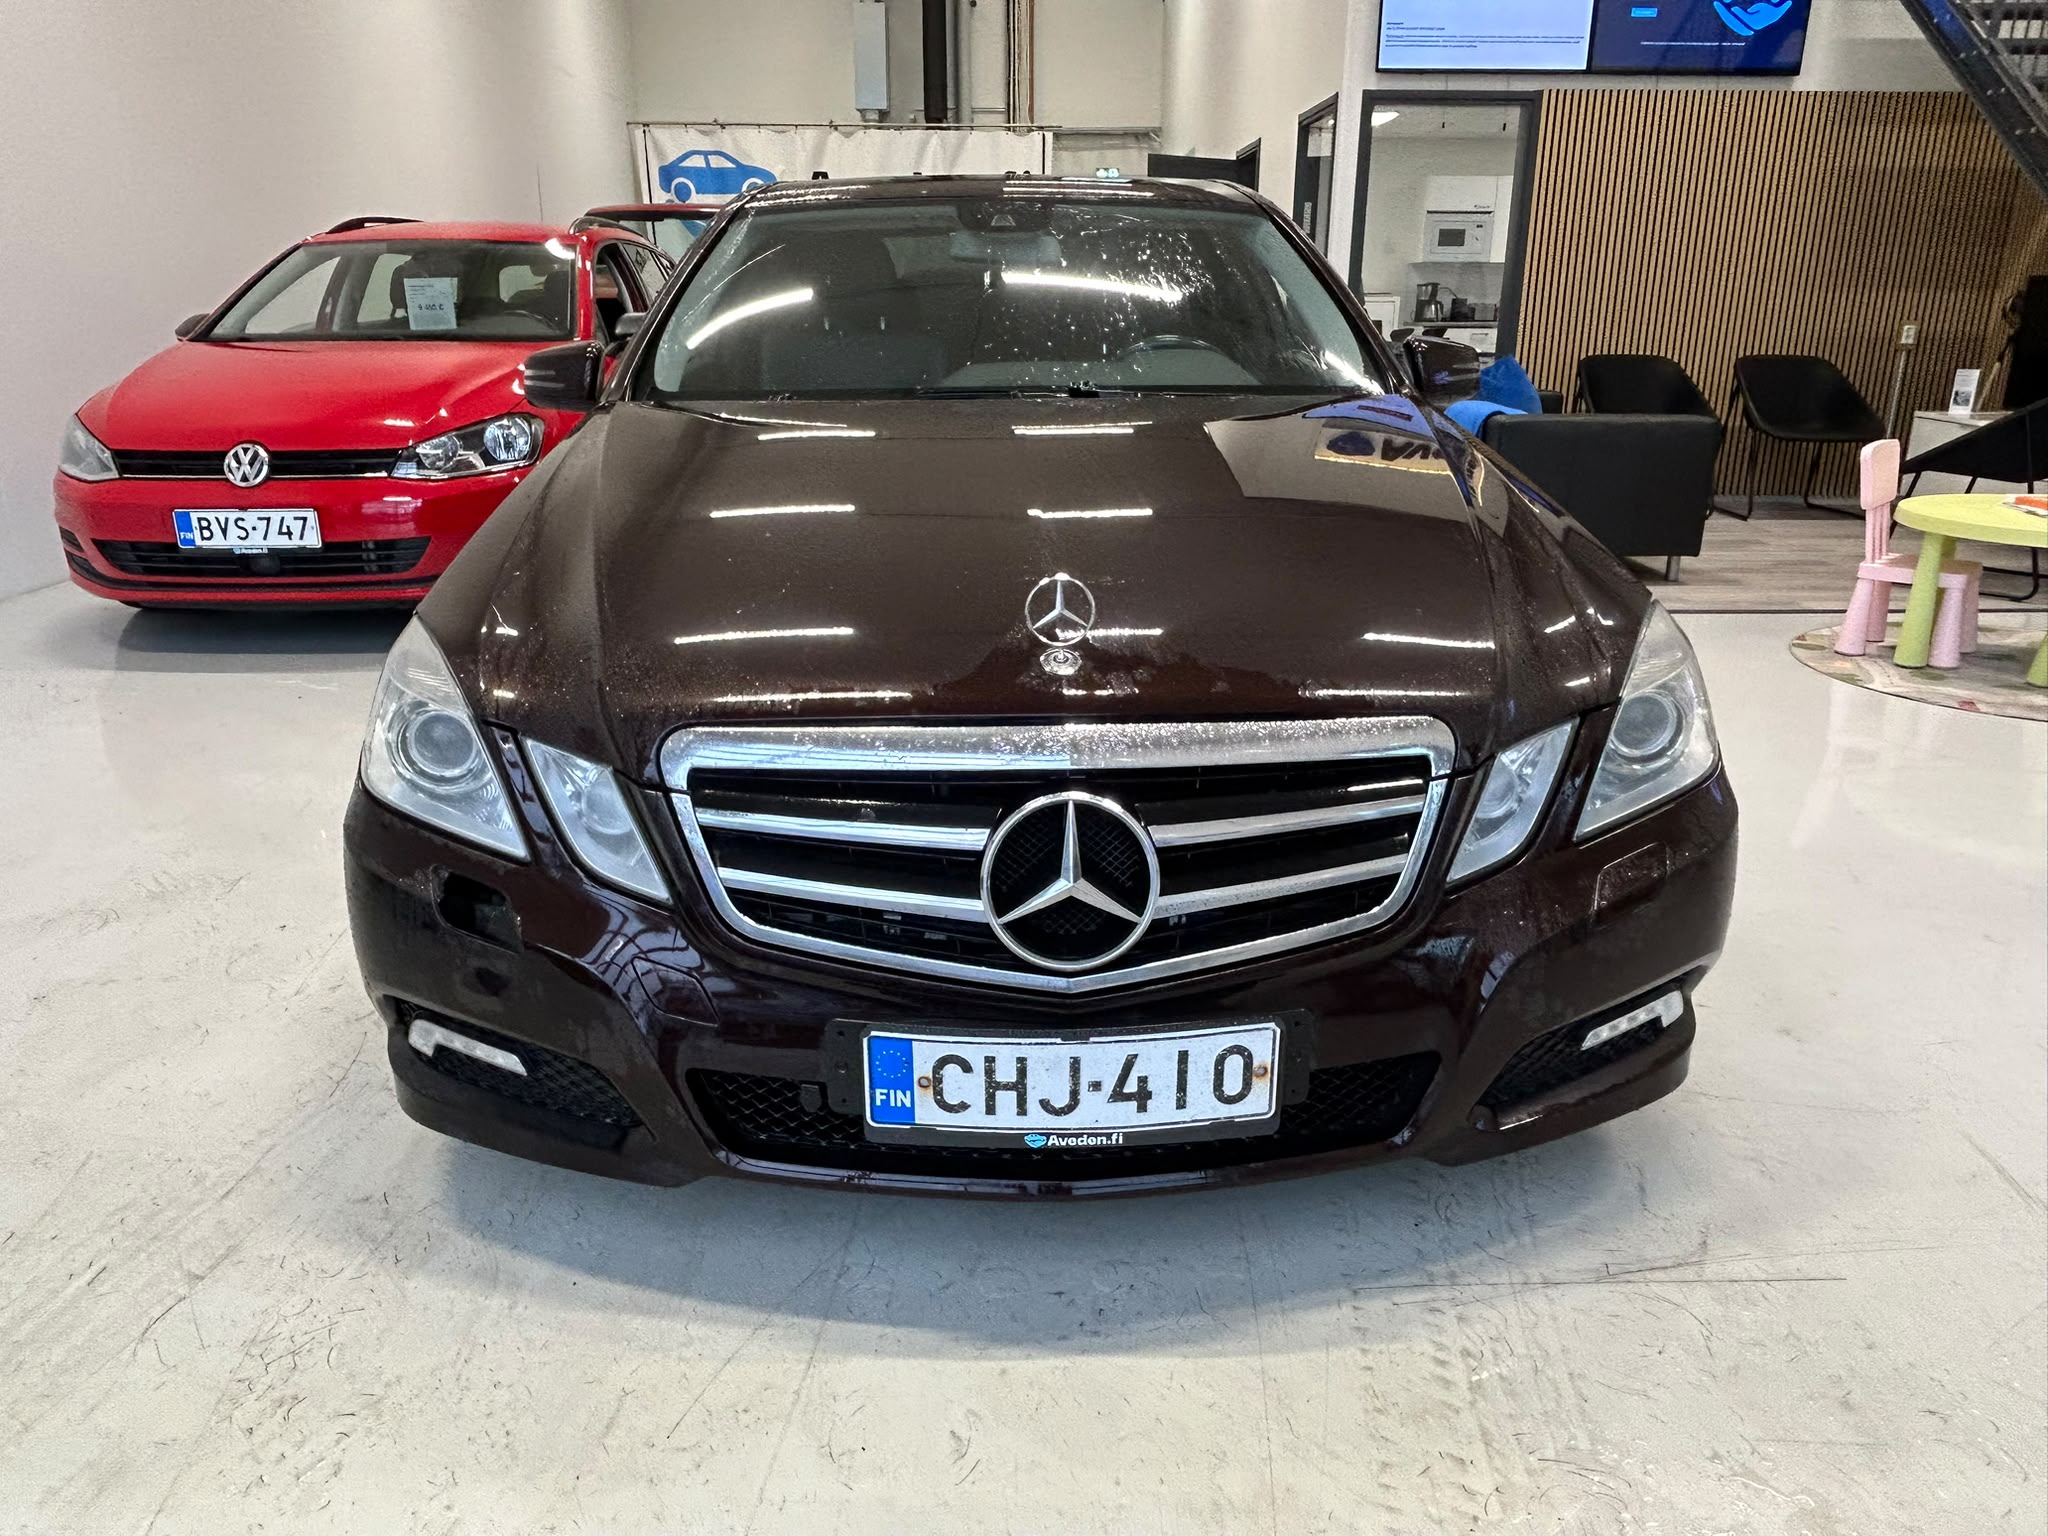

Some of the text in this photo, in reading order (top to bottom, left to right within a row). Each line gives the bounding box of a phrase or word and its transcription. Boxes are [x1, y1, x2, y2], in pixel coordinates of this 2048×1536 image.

[197, 515, 309, 541] BVS-747
[932, 1043, 1254, 1118] CHJ-410
[875, 1088, 912, 1108] FIN
[1047, 1132, 1124, 1147] Avedon.fi
